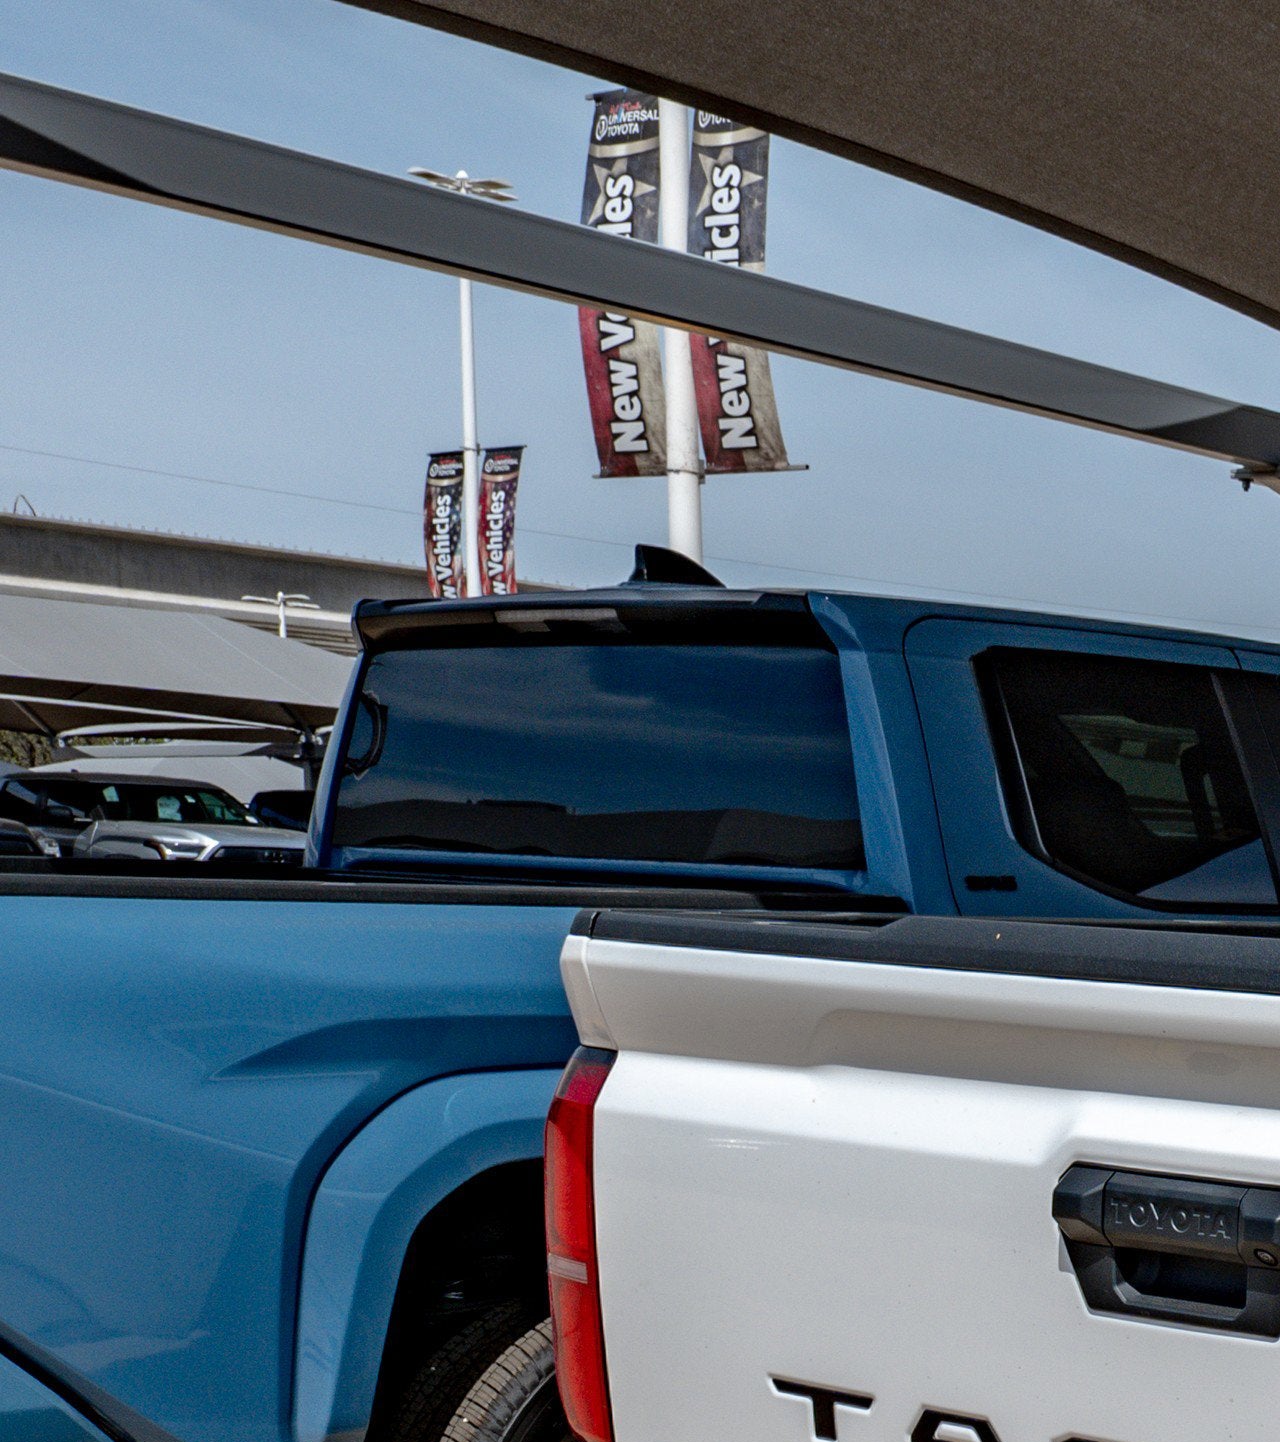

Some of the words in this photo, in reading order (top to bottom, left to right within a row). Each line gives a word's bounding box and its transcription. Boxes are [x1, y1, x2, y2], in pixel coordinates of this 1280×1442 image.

[607, 122, 641, 137] TOYOTA
[610, 358, 649, 454] New
[716, 354, 758, 450] New
[432, 494, 452, 582] Vehicles
[486, 490, 506, 578] Vehicles
[1110, 1200, 1231, 1240] TOYOTA
